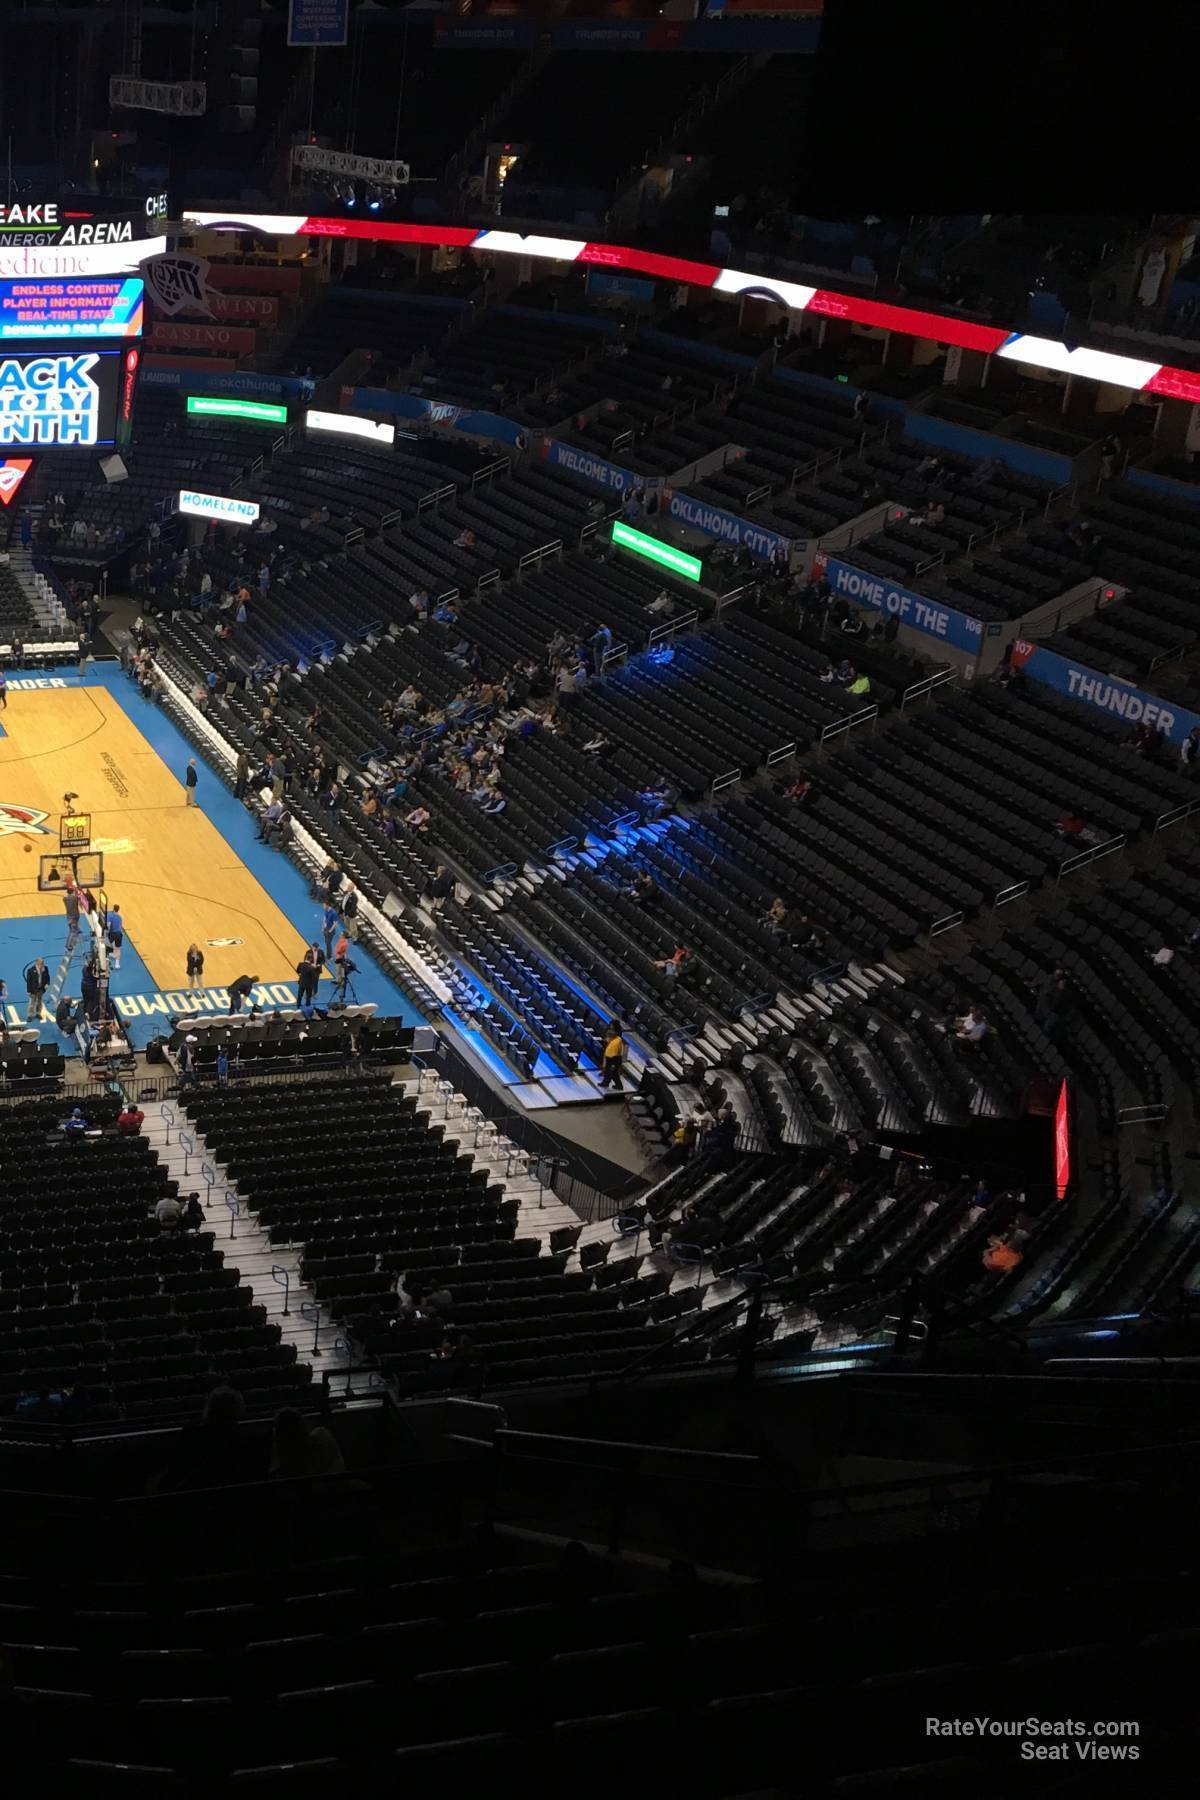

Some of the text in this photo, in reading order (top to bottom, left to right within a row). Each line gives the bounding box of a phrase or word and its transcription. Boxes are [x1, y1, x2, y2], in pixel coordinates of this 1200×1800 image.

[59, 221, 133, 246] ARENA
[12, 284, 121, 295] ENDLESS CONTENT
[3, 296, 130, 308] PLAYER INFORMATION
[17, 309, 116, 320] REAL-TIME STATS
[154, 326, 231, 343] CASINO
[557, 446, 609, 484] WELCOME
[609, 469, 624, 489] TO
[182, 493, 257, 517] HOMELAND
[670, 498, 741, 545] OKLAHOMA
[743, 528, 778, 558] CITY
[836, 569, 950, 636] HOME OF THE
[964, 618, 984, 635] 106
[1015, 639, 1033, 657] 107
[1067, 669, 1176, 737] THUNDER
[113, 983, 298, 1018] OKAHOMA
